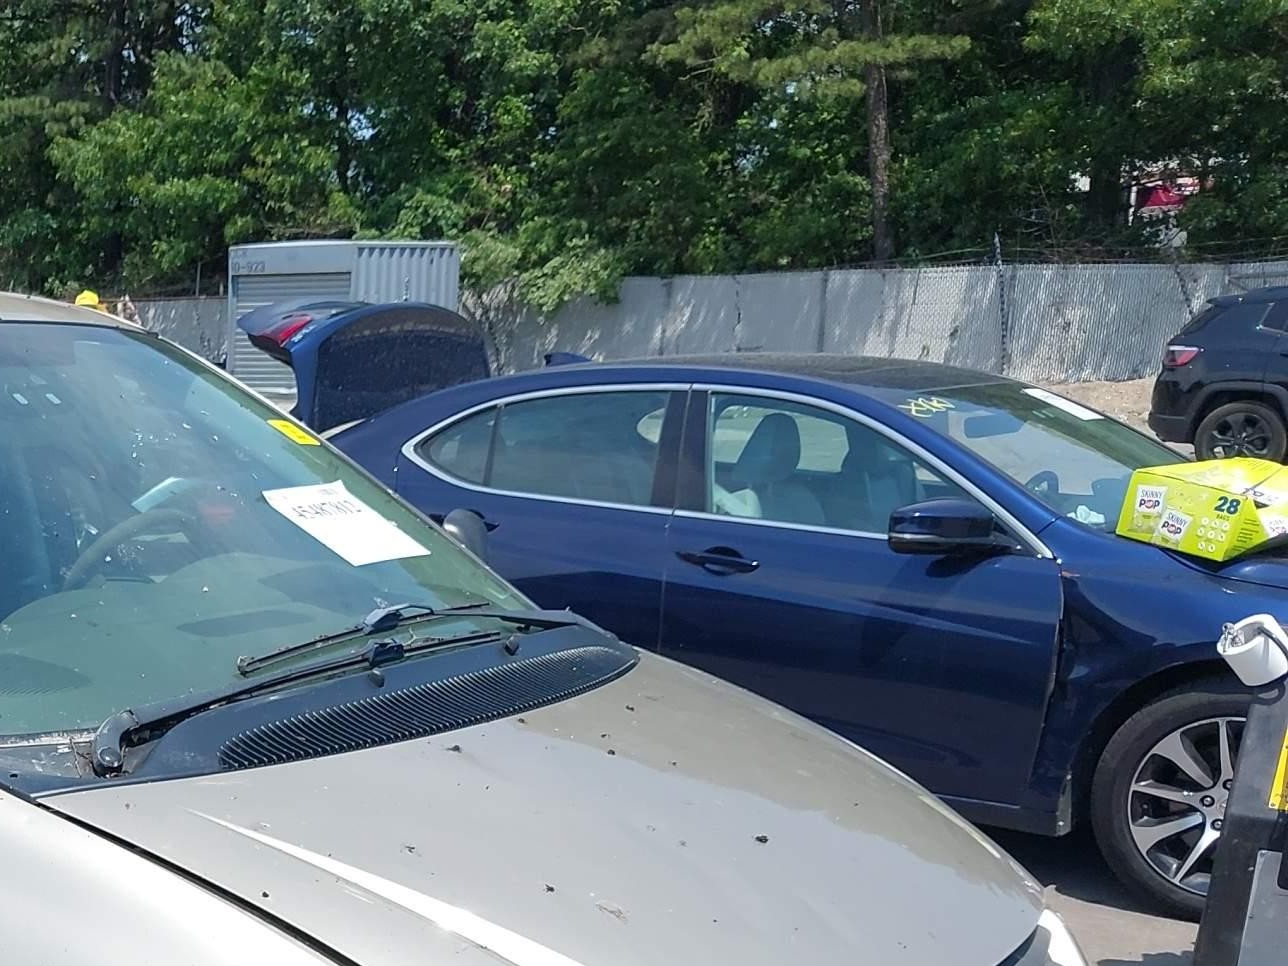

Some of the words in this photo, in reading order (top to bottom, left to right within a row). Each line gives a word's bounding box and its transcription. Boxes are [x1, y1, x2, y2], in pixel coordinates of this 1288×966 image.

[1141, 489, 1163, 498] SKINNY
[1139, 498, 1161, 509] POP
[1214, 496, 1241, 515] 28
[1167, 512, 1188, 527] SKINNY
[1161, 521, 1182, 535] POP
